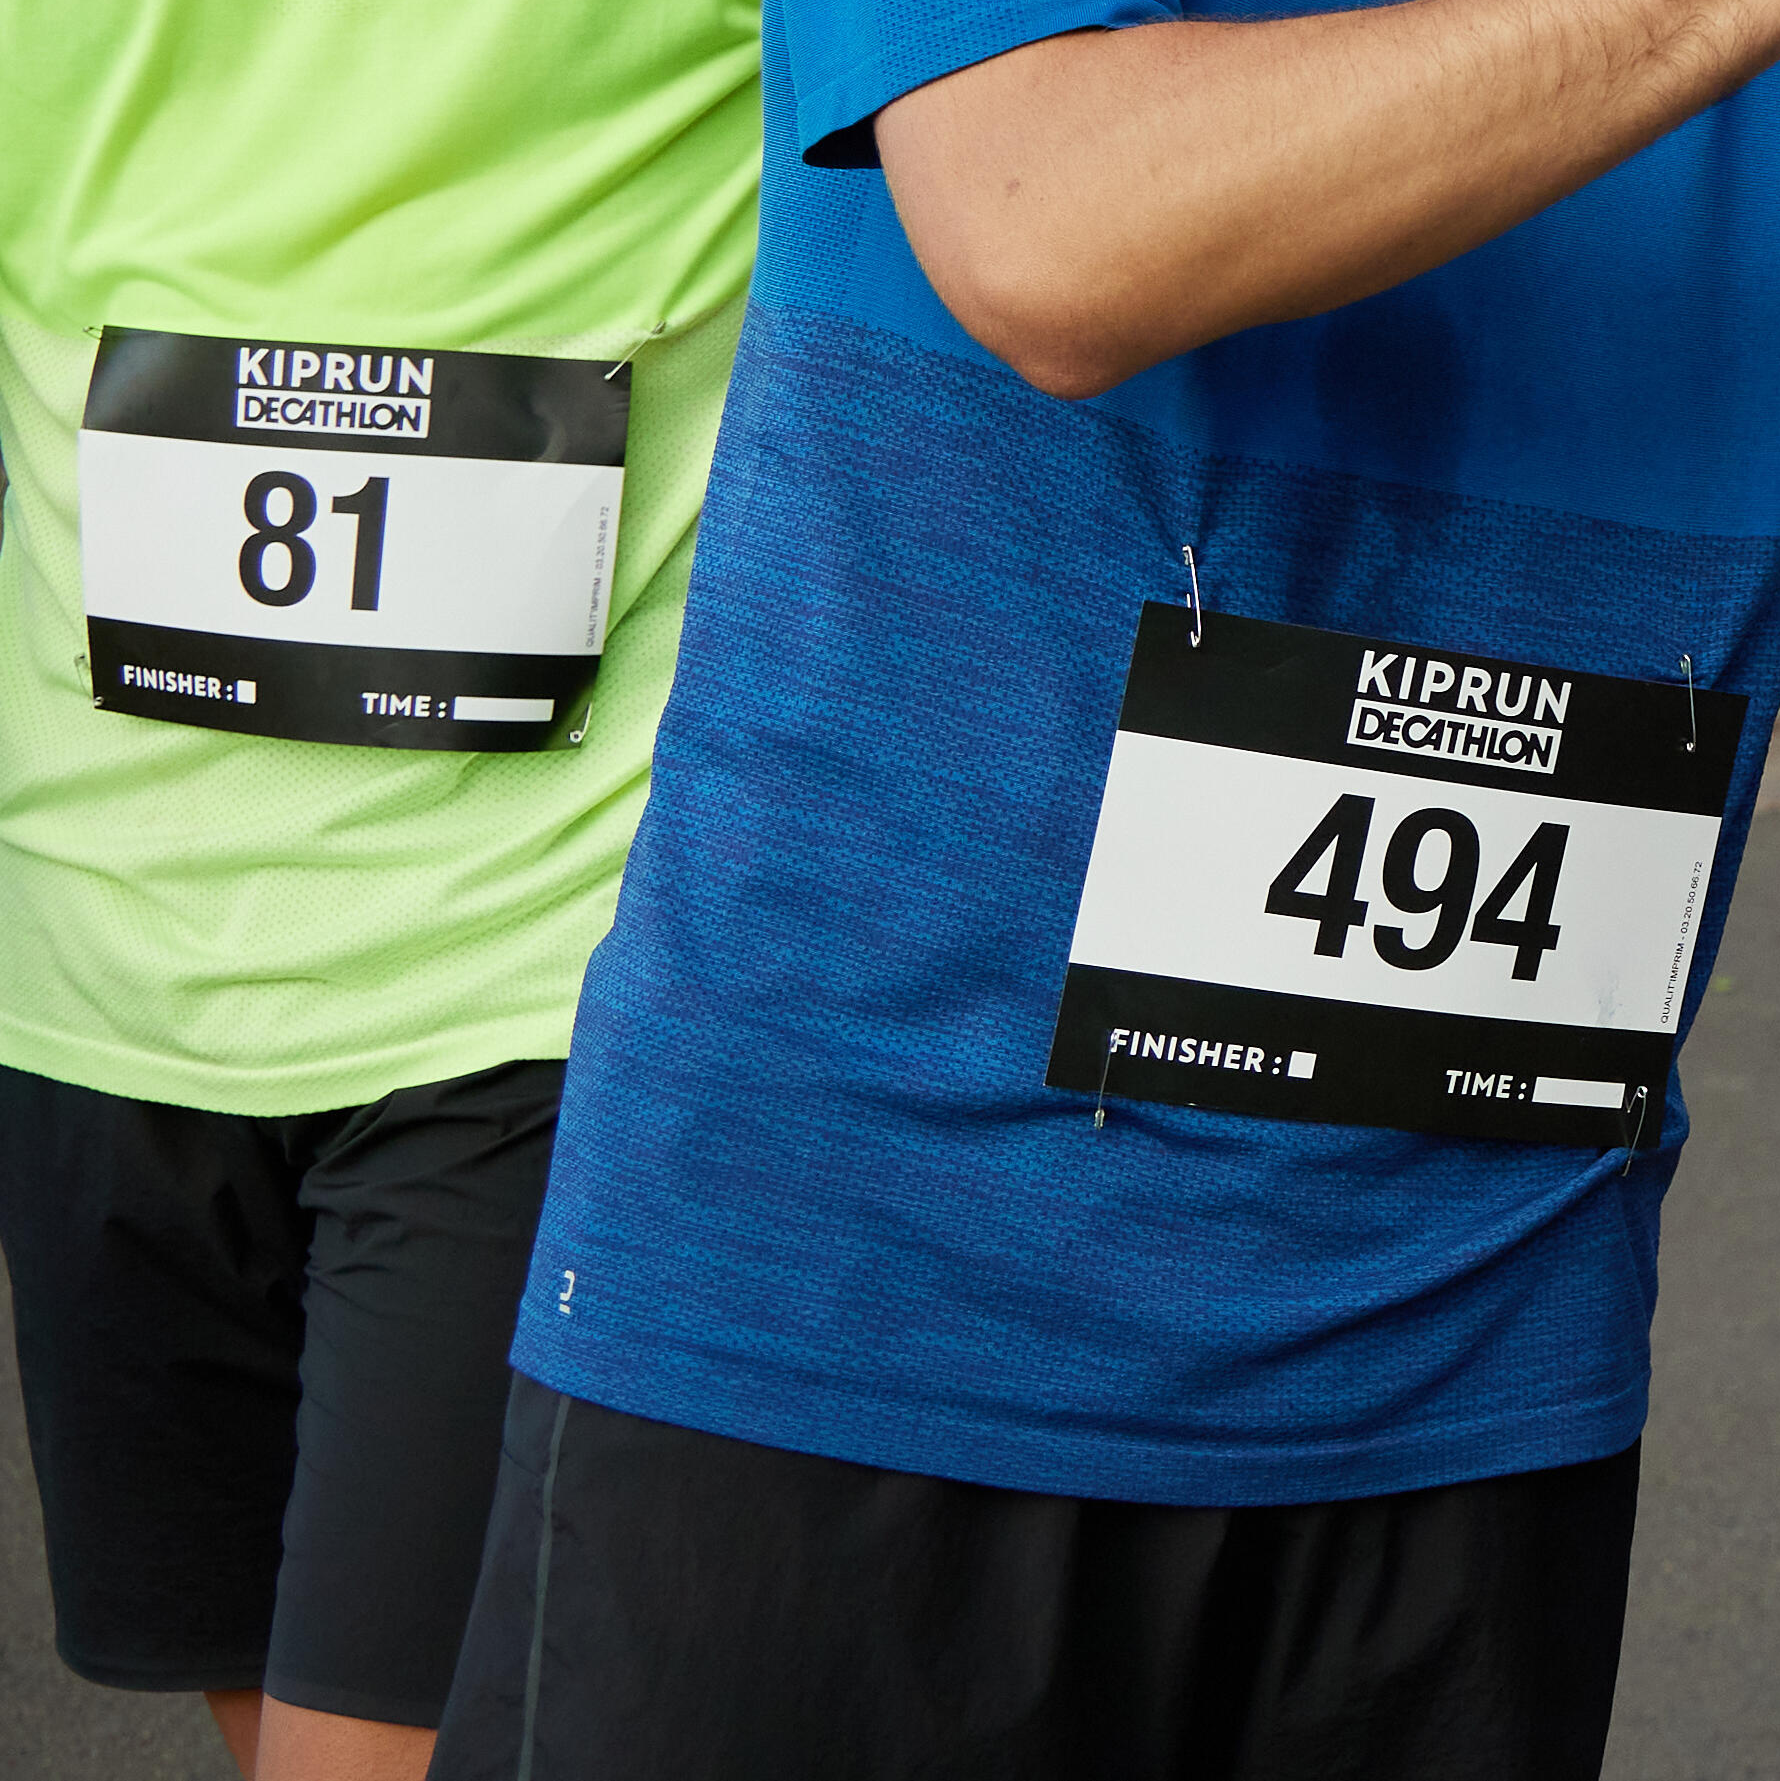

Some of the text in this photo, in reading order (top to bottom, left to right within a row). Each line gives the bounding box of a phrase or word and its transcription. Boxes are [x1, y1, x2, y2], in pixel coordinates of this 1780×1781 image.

[237, 347, 435, 396] KIPRUN
[242, 394, 424, 433] DECATHLON
[237, 469, 391, 613] 81
[1356, 649, 1572, 724] KIPRUN
[1353, 705, 1555, 768] DECATHLON
[1264, 793, 1571, 982] 494
